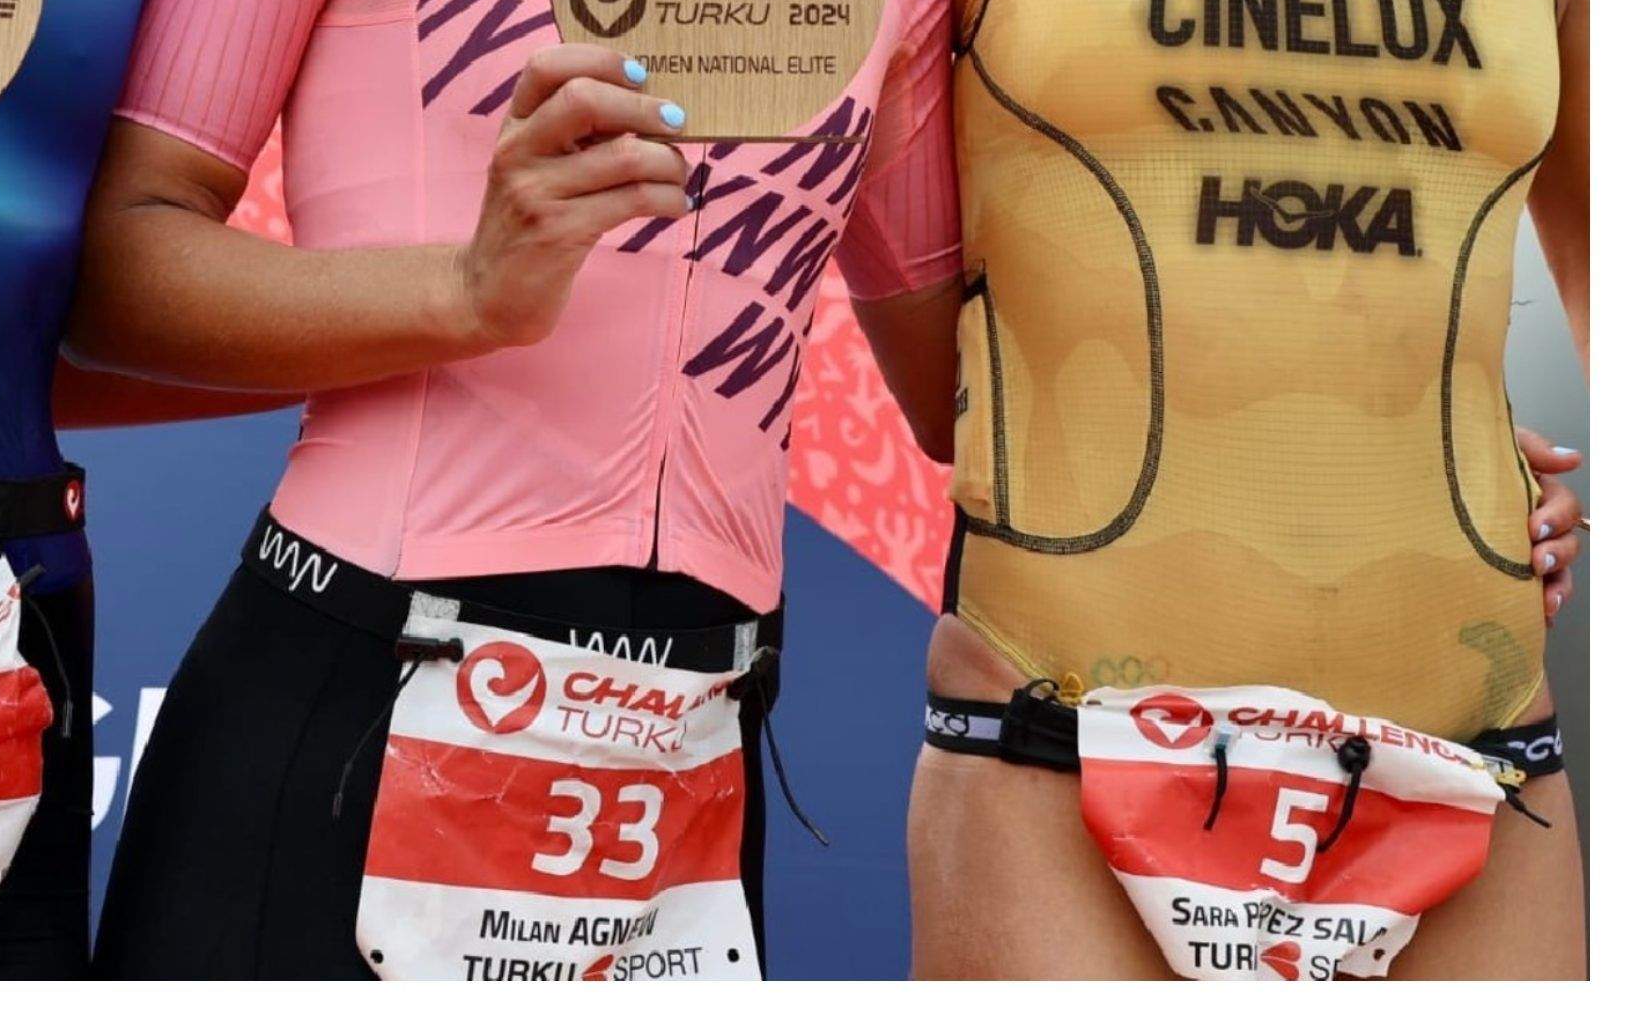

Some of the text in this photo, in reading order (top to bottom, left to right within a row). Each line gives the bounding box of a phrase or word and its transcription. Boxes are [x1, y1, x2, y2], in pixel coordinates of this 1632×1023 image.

[654, 2, 851, 27] TURKU 2024
[635, 54, 837, 75] OMEN NATIONAL ELITE
[1155, 85, 1464, 153] CANYON
[530, 778, 665, 881] 33
[1260, 788, 1333, 884] 5
[613, 946, 703, 981] SPORT
